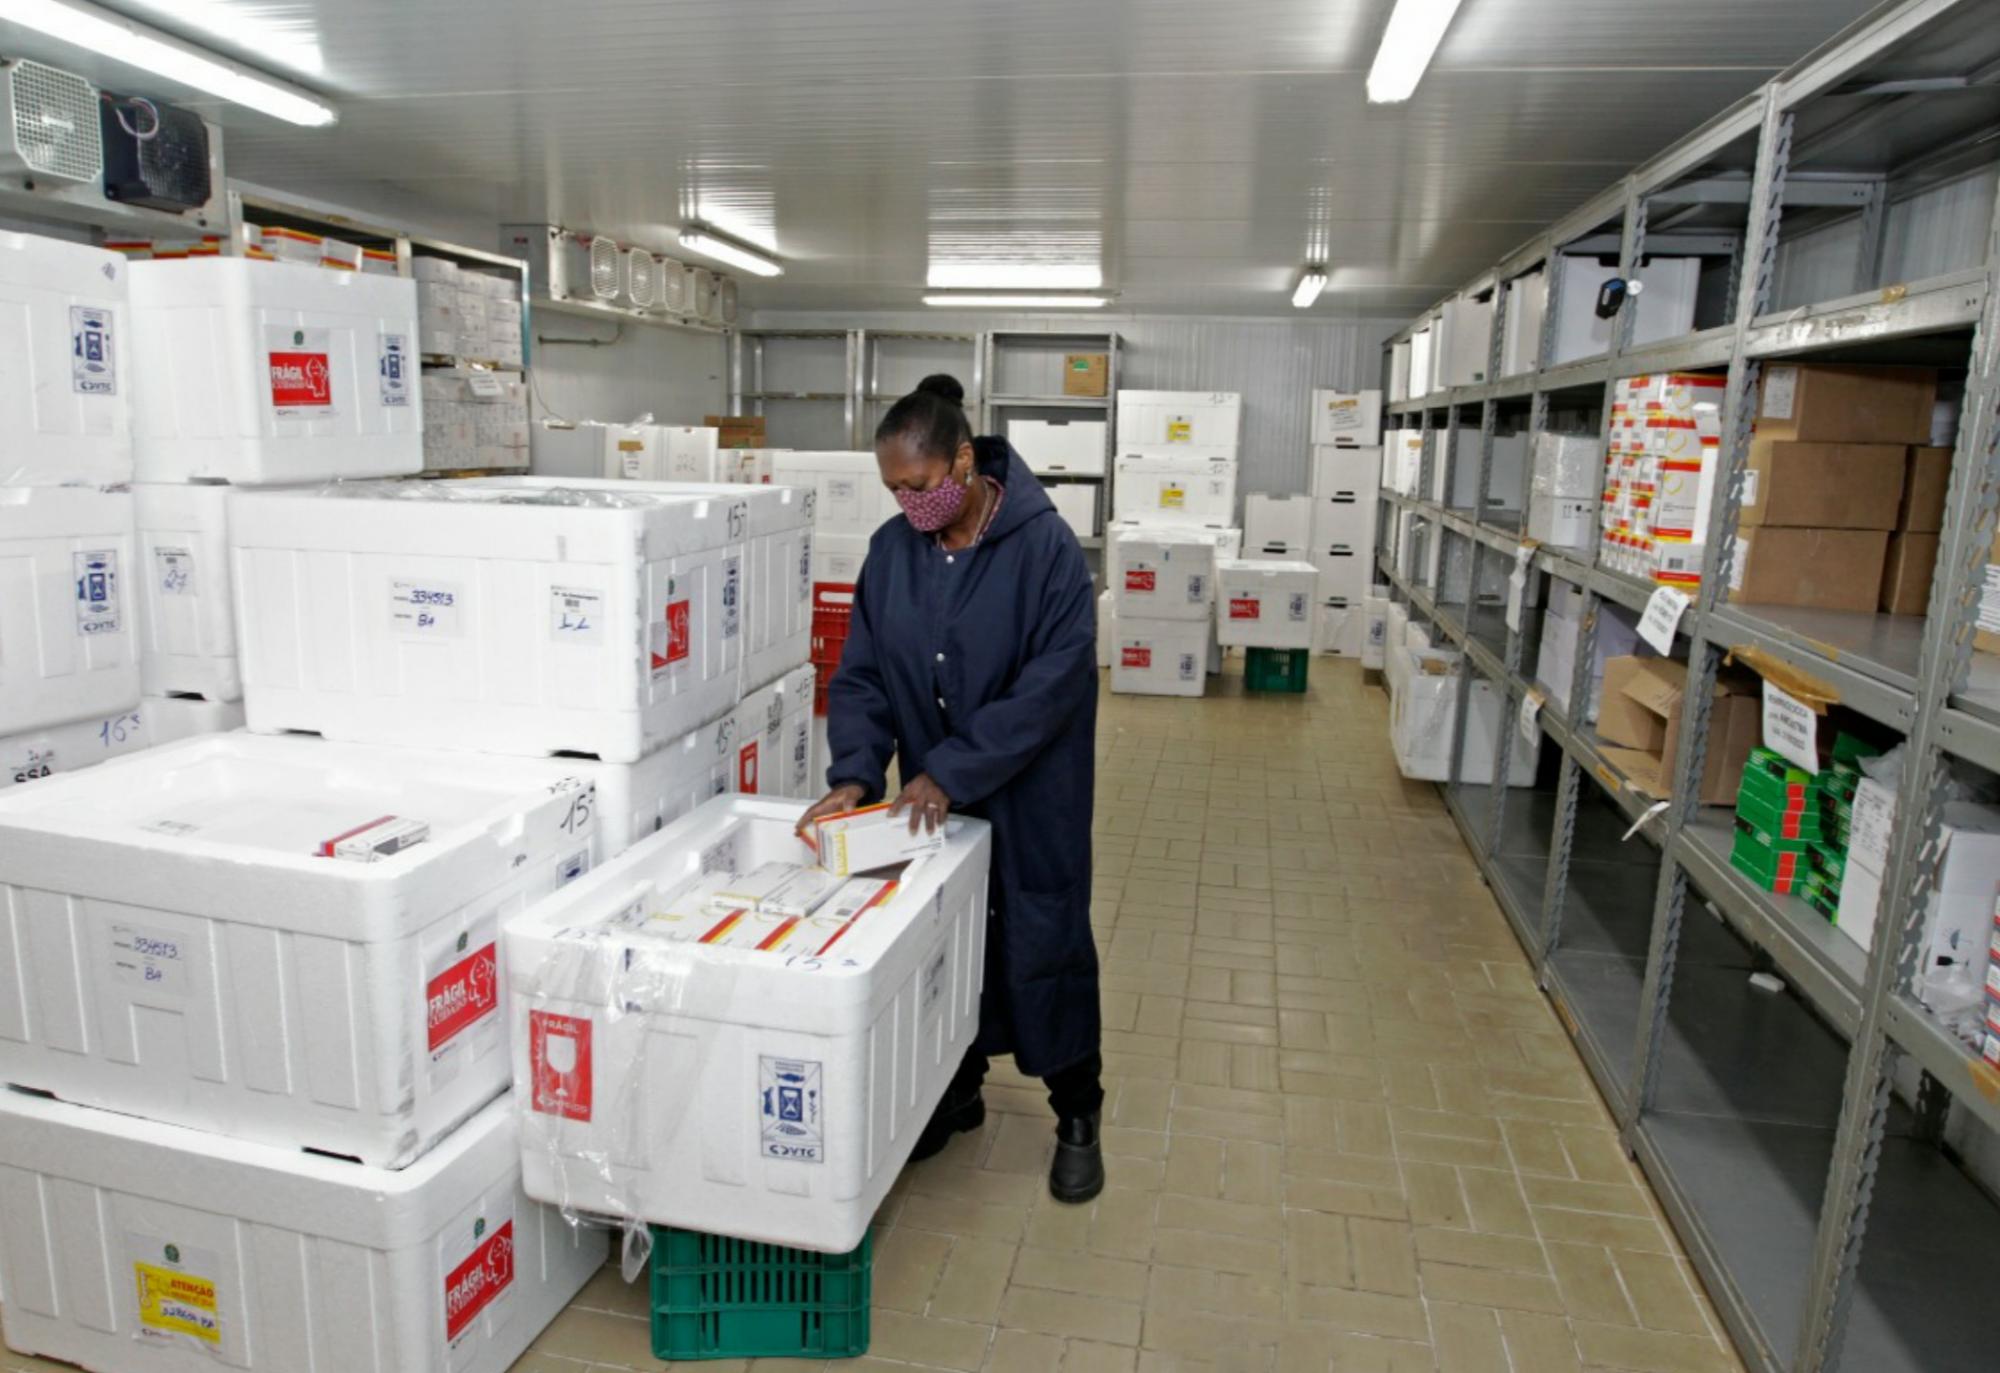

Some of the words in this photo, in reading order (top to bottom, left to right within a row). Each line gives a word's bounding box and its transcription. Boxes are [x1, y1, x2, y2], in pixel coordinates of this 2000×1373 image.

[271, 364, 304, 380] FRÁGIL
[428, 977, 467, 1013] FRÁGIL
[447, 1262, 486, 1310] FRÁGIL
